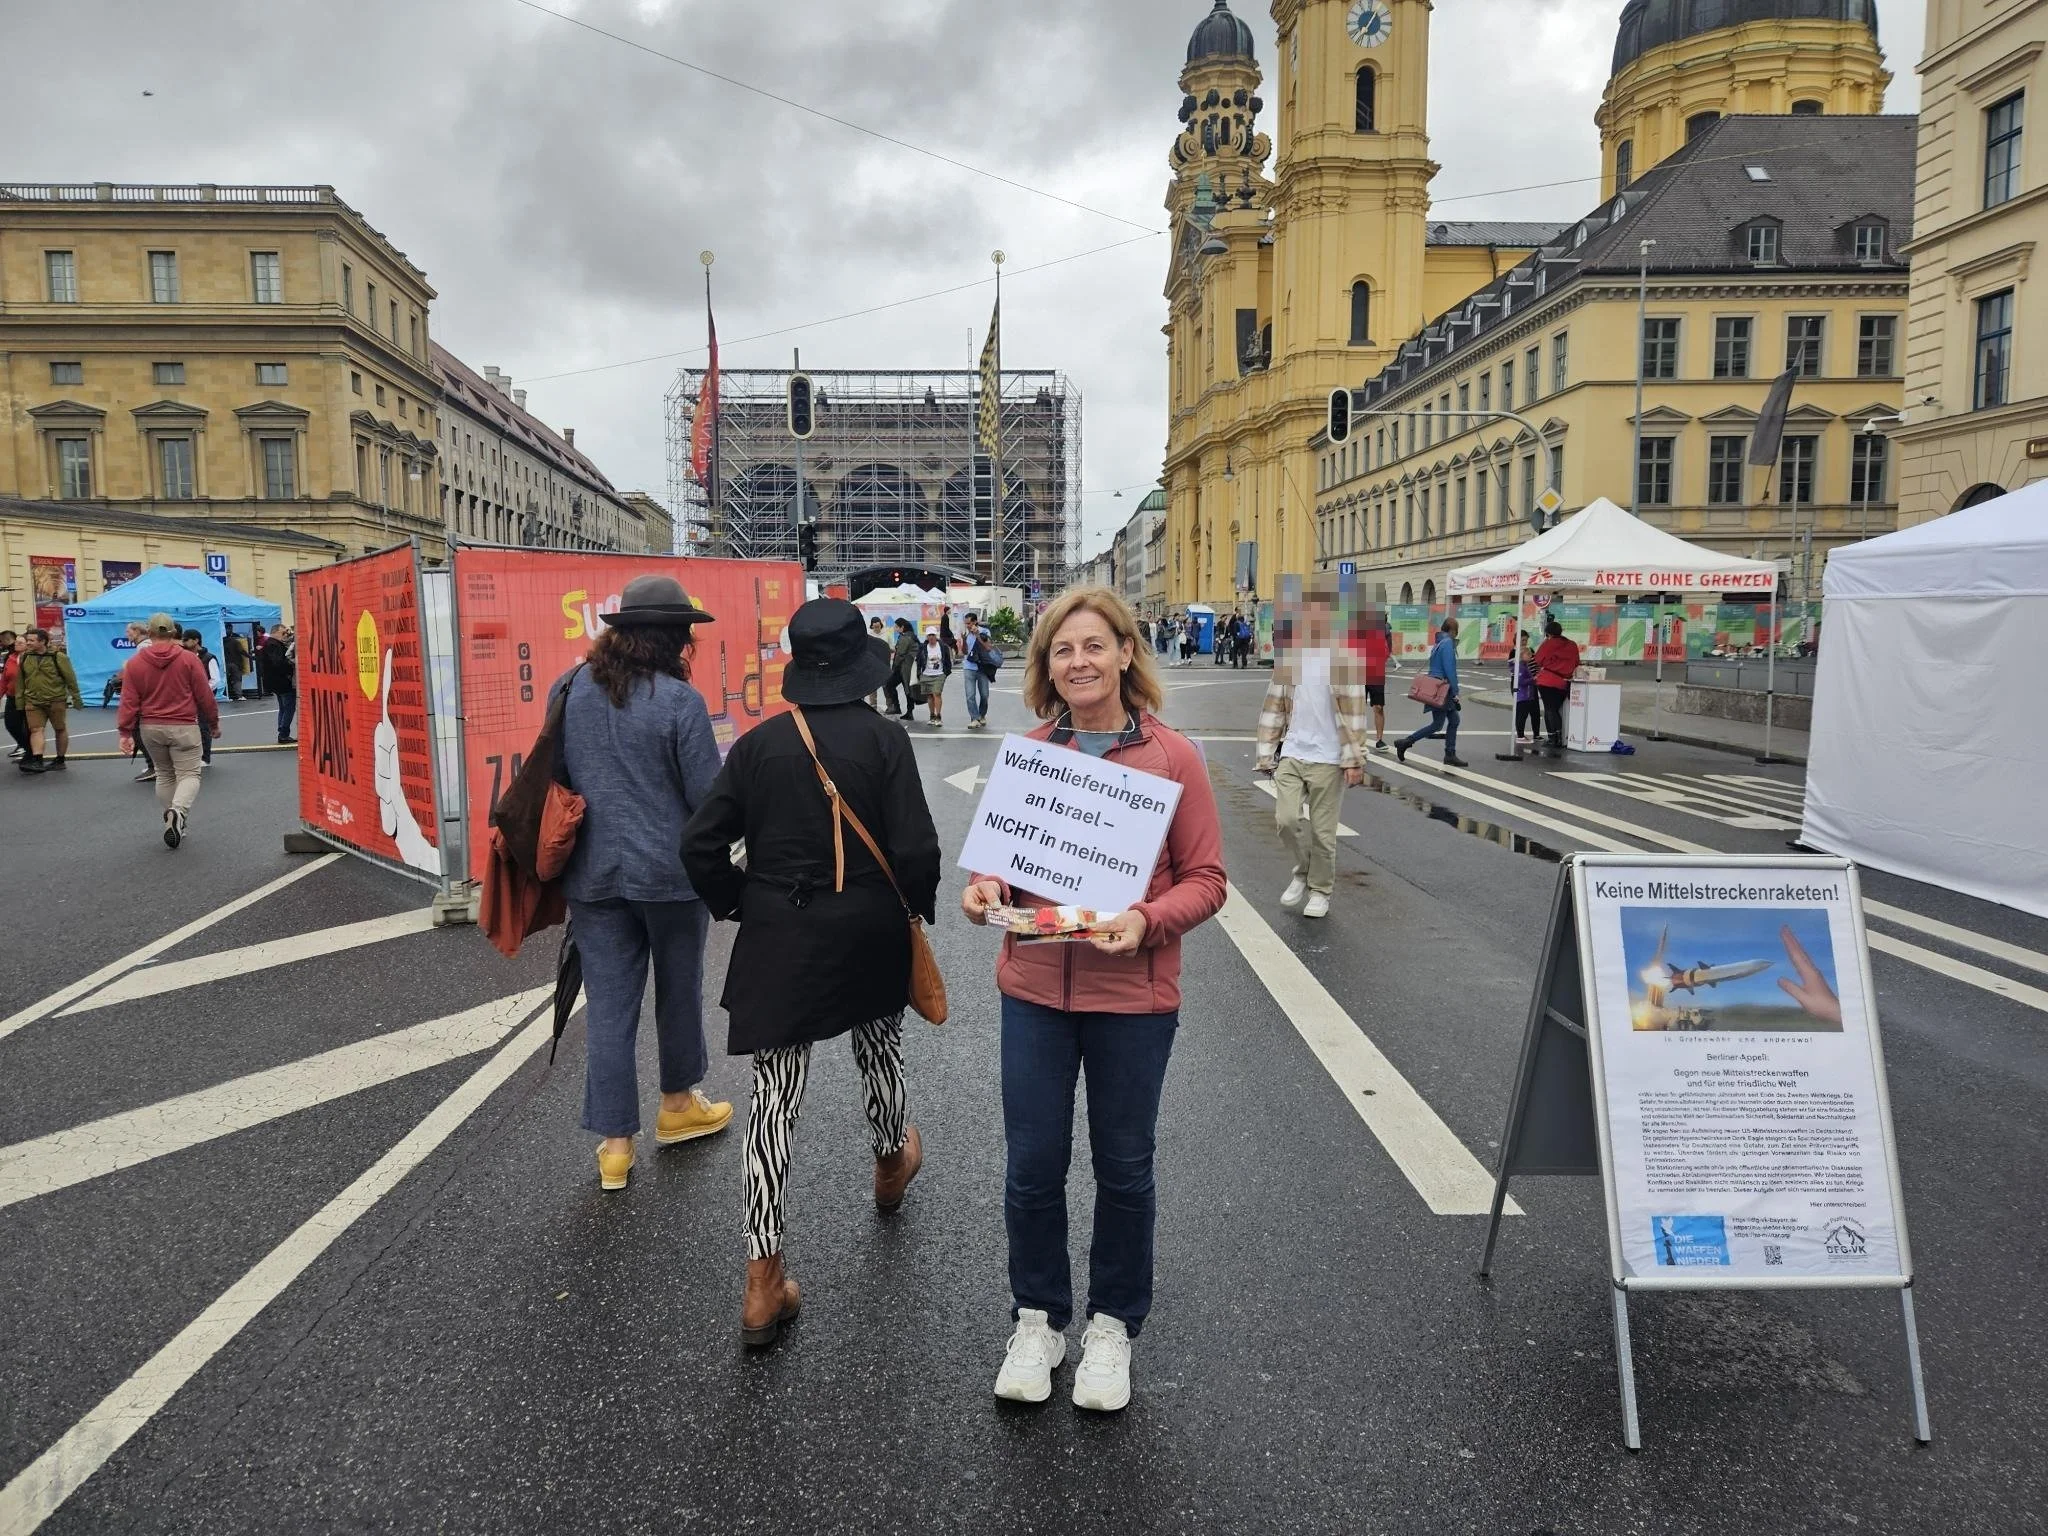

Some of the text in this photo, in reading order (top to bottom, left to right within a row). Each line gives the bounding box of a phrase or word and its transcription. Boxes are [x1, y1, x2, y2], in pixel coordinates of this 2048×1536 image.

[211, 557, 222, 571] U
[1595, 570, 1643, 586] ÄRZTE
[1649, 573, 1693, 586] OHNE
[1700, 573, 1773, 587] GRENZEN
[1004, 750, 1166, 815] Waffenlieferungen
[1025, 792, 1046, 808] an
[1049, 797, 1100, 826] Israel
[984, 811, 1139, 877] NICHT in meinem
[1010, 853, 1083, 891] Namen!
[1595, 881, 1839, 901] Keine Mittelstreckenraketen!
[1673, 1068, 1699, 1078] Gegen
[1723, 1069, 1809, 1077] Mittelstreckenwaffen
[1674, 1234, 1694, 1244] DIE
[1674, 1245, 1721, 1254] WAFFEN
[1676, 1257, 1721, 1265] NIEDER
